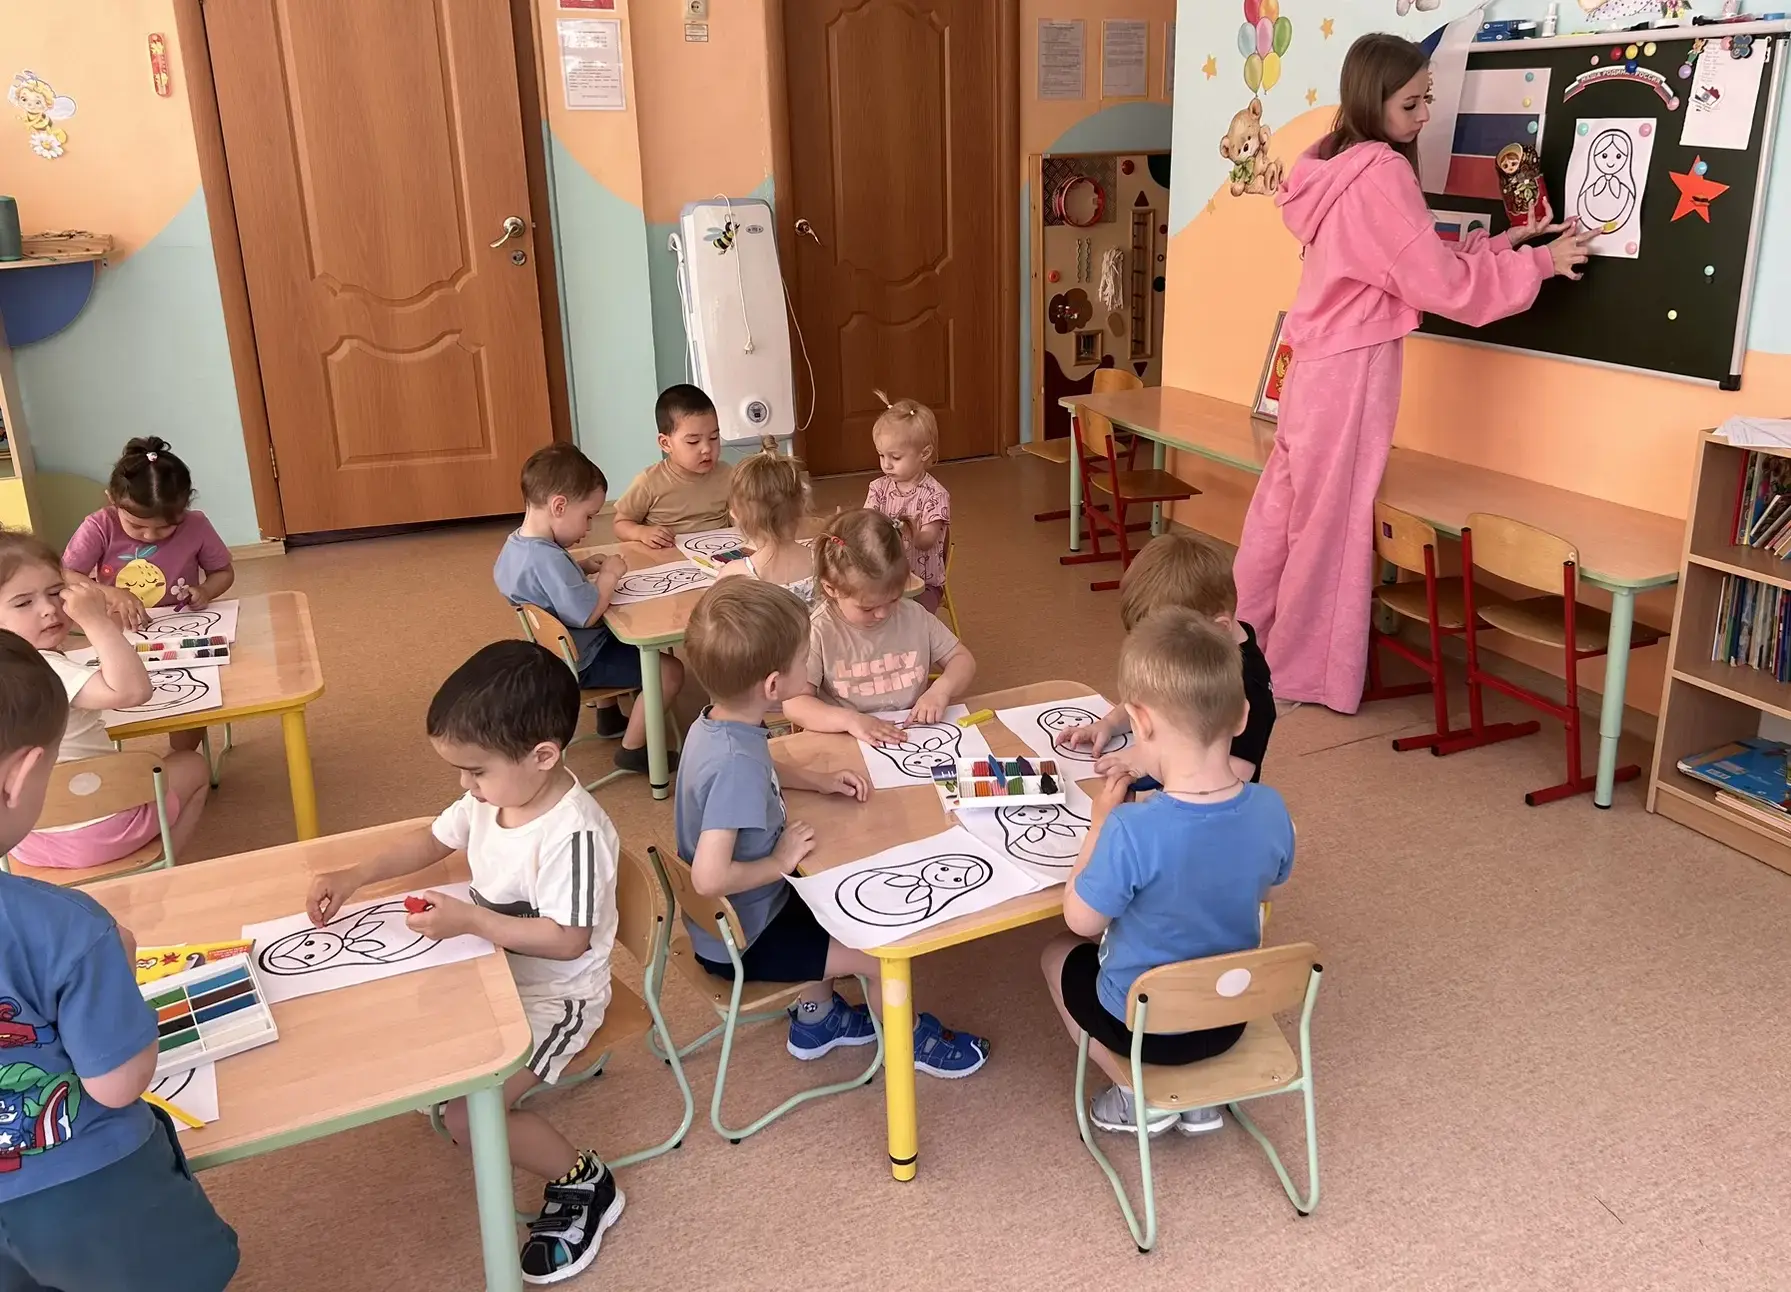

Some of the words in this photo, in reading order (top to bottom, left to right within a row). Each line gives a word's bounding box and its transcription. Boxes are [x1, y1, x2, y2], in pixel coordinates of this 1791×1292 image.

[1581, 72, 1602, 83] НАША
[1634, 71, 1661, 84] РОССИЯ
[835, 650, 918, 679] Lucky
